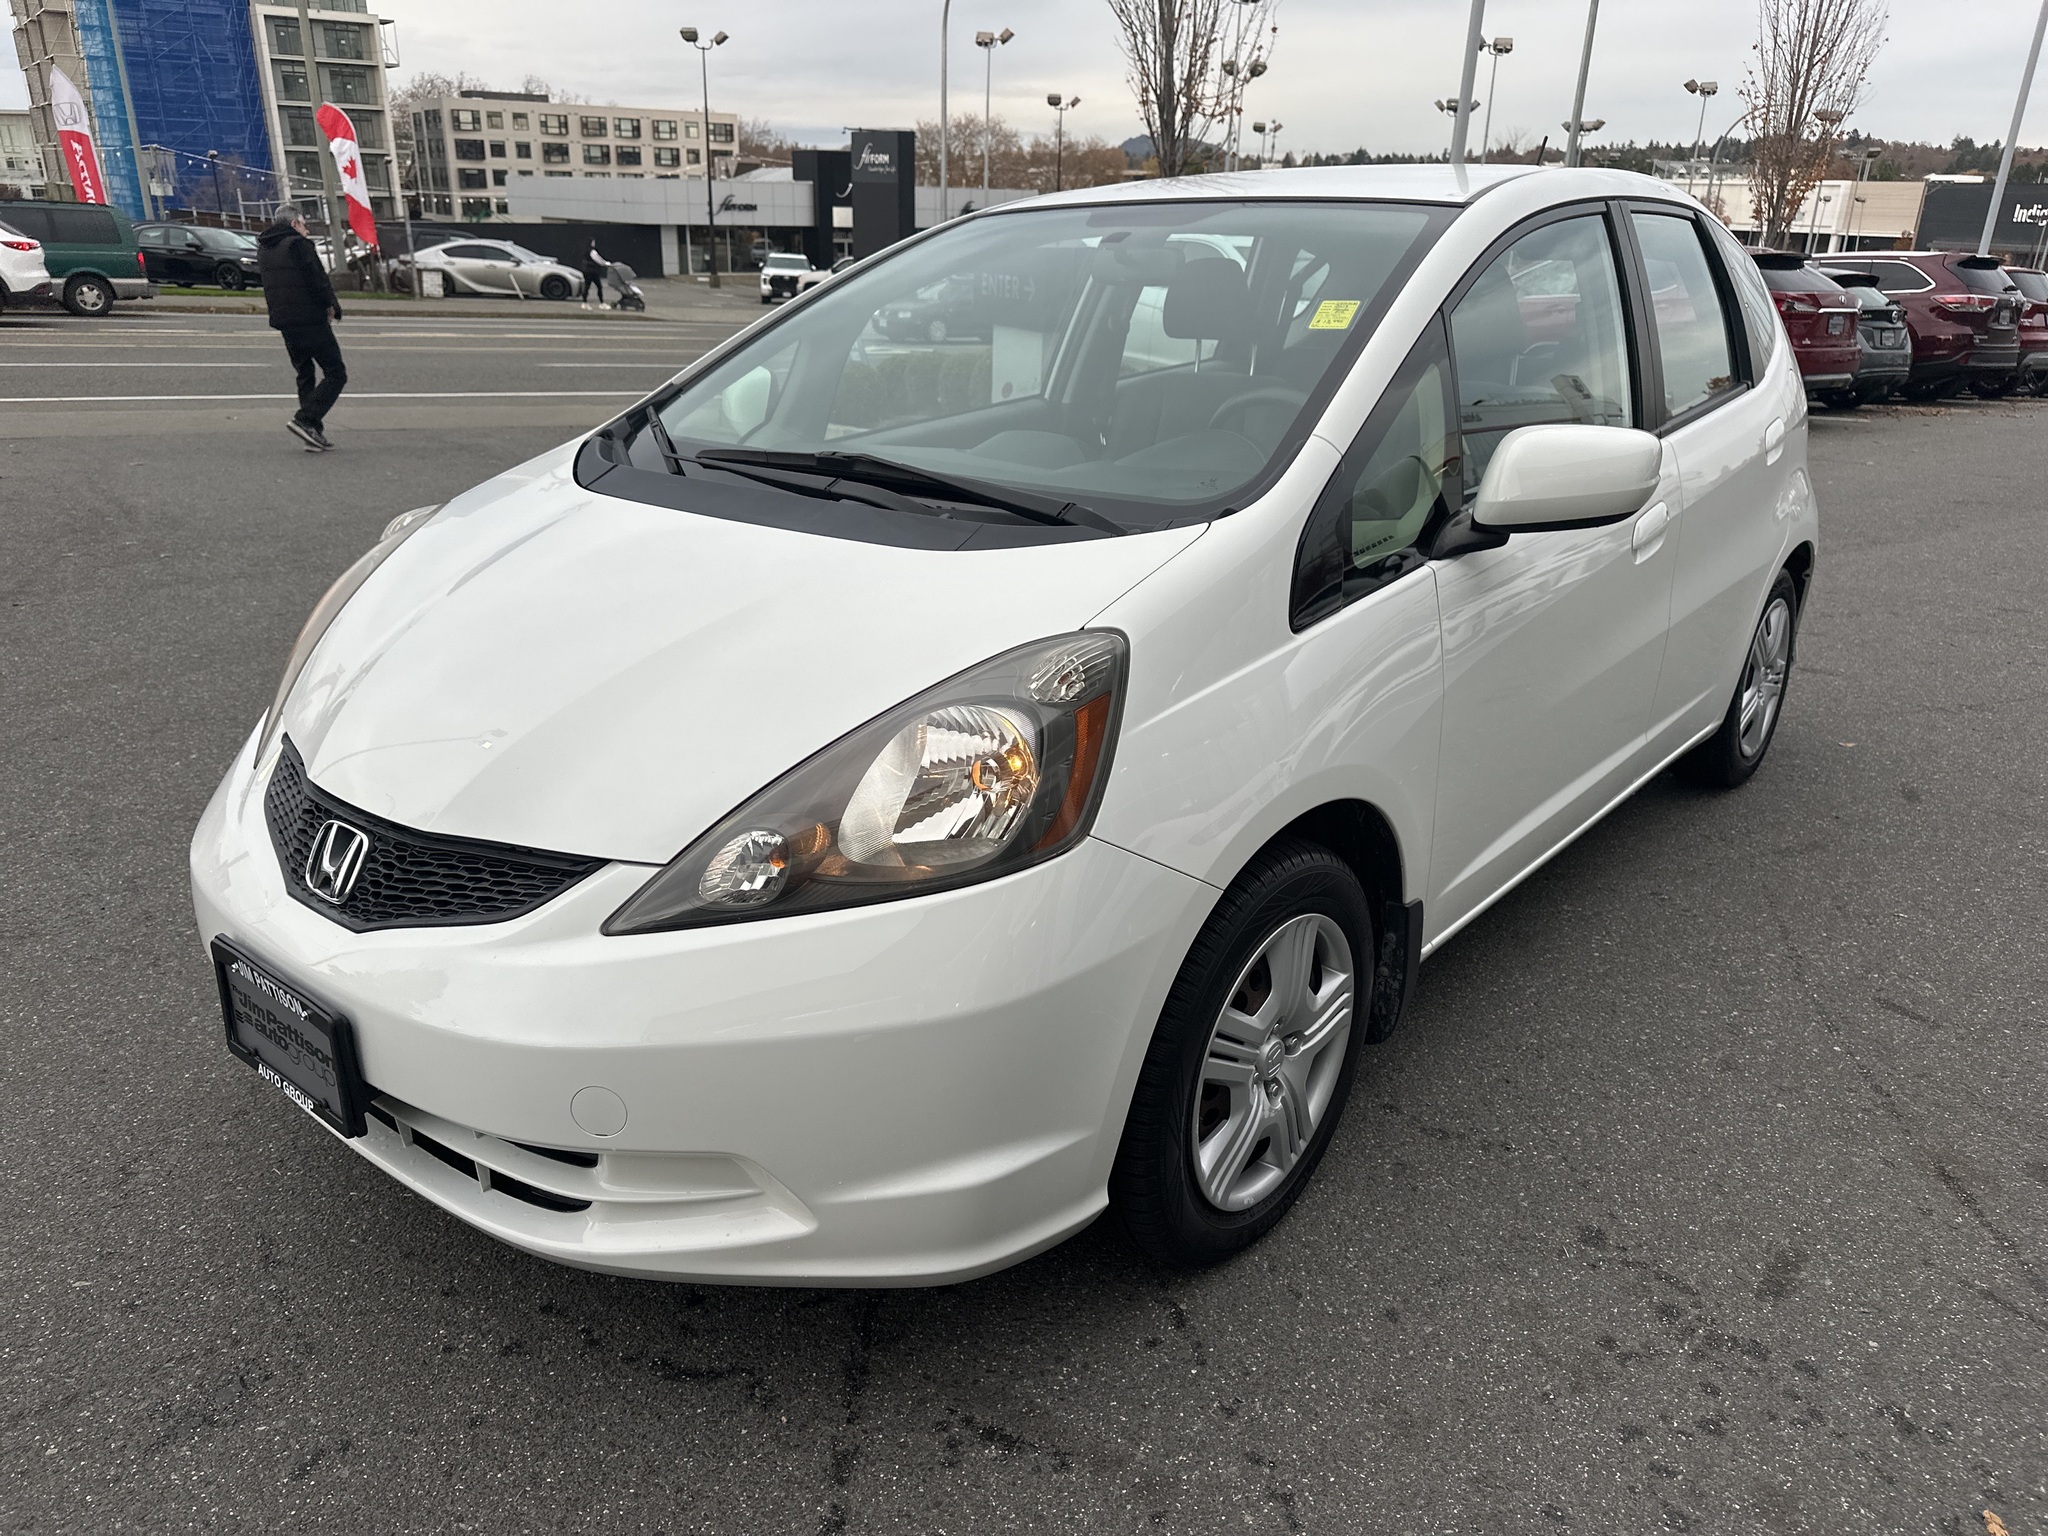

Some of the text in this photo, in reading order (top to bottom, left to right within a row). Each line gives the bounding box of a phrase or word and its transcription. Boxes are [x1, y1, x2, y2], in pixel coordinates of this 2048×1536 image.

[982, 273, 1020, 299] ENTER
[237, 960, 303, 1016] JIM PATTISON
[257, 1063, 314, 1111] AUTO GROUP
